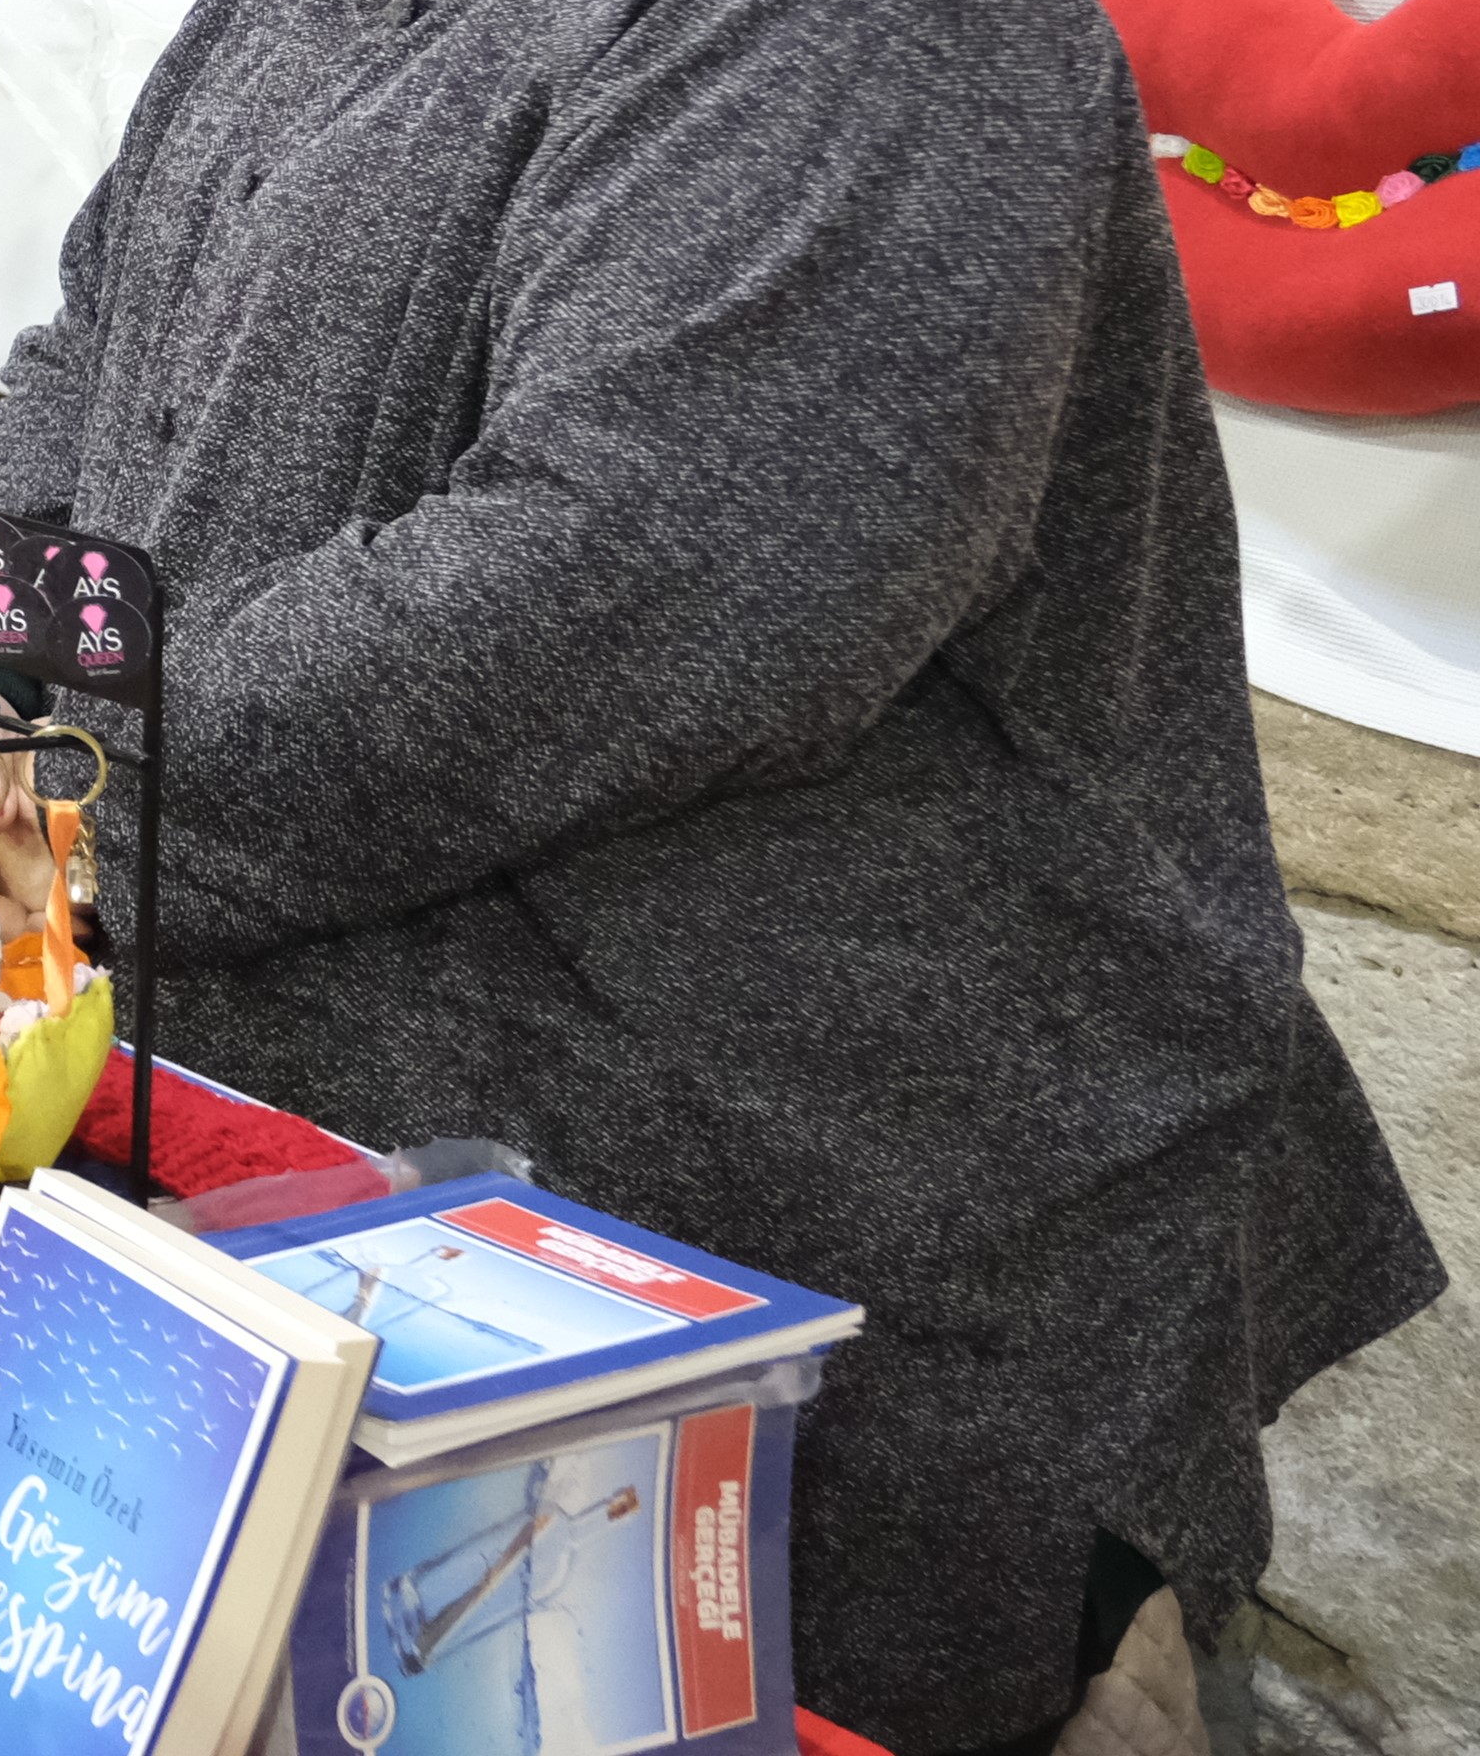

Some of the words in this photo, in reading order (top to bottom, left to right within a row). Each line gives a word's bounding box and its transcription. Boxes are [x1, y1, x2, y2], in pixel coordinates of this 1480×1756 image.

[73, 577, 121, 599] AYS
[77, 627, 123, 654] AYS
[77, 651, 126, 669] QUEEN
[5, 1412, 87, 1496] Yasemin
[90, 1464, 144, 1535] Özek
[717, 1479, 743, 1642] MÜBADELE
